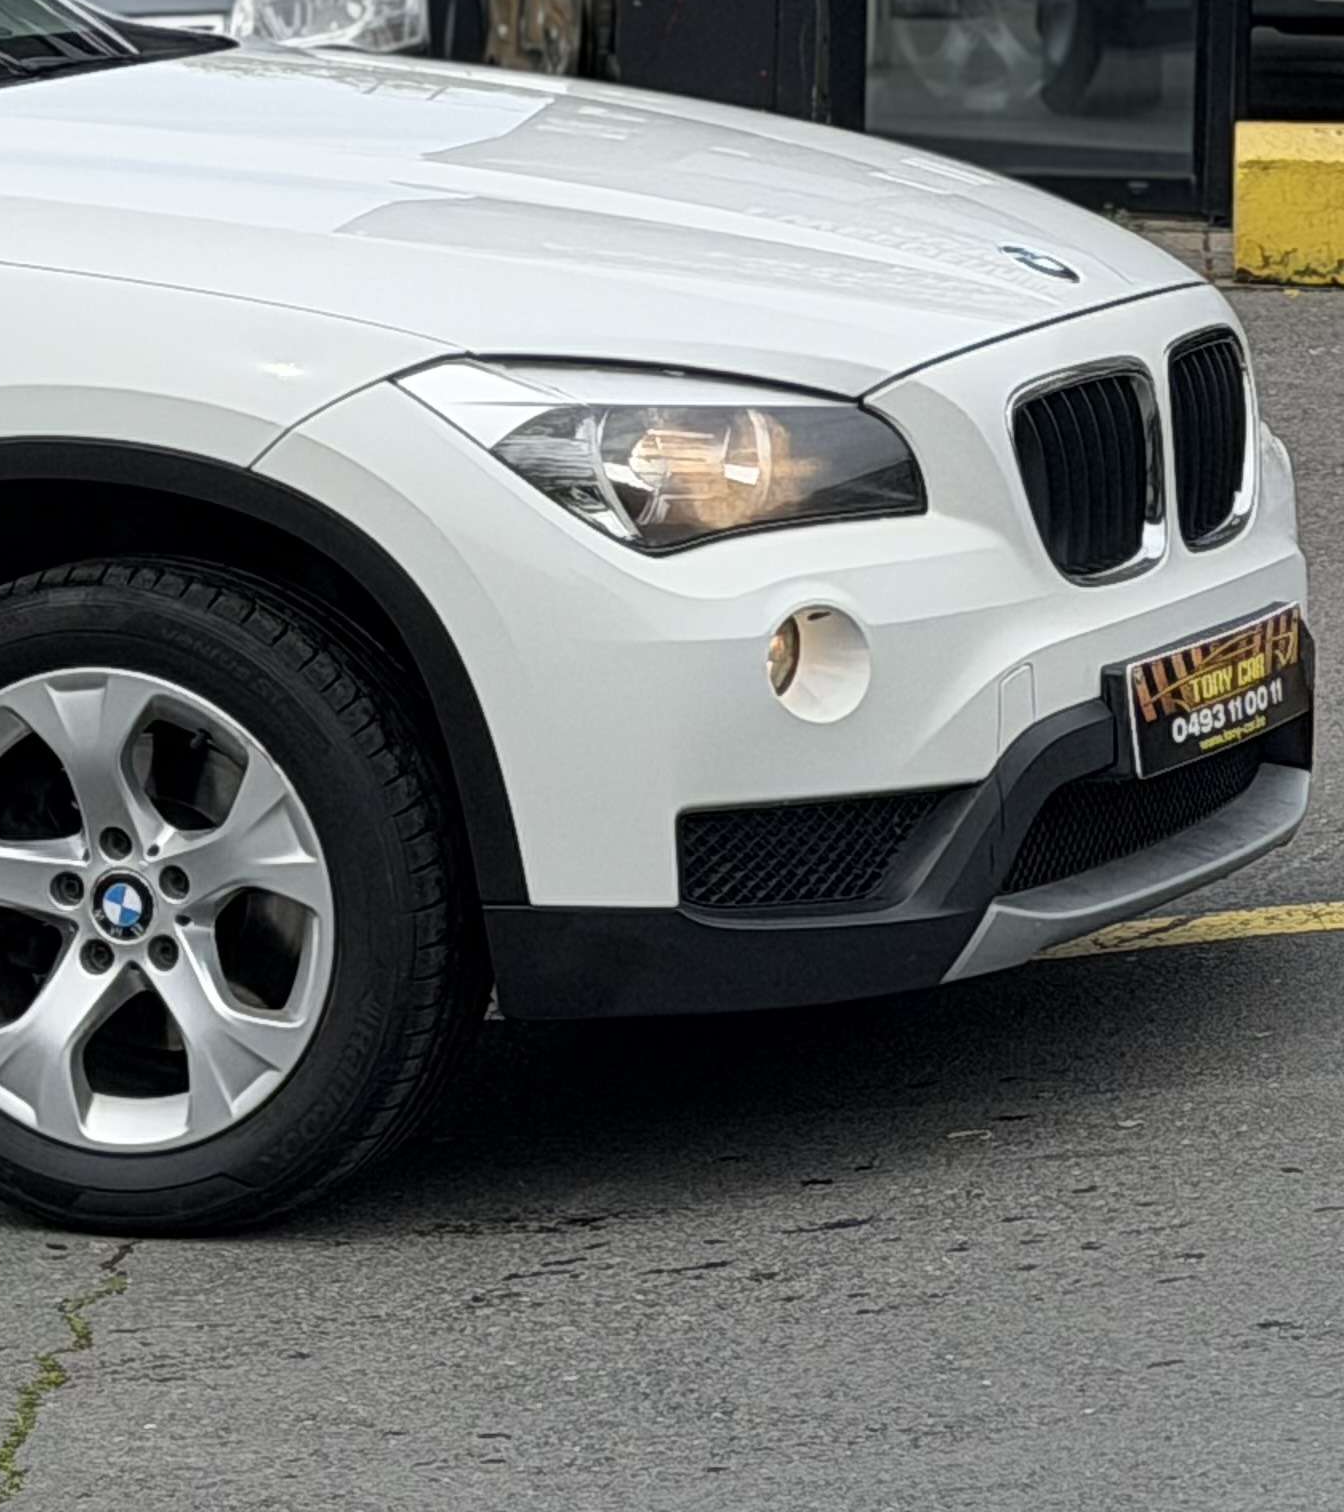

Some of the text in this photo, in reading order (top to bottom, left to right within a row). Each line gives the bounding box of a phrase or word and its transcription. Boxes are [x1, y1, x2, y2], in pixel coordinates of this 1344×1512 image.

[1188, 653, 1265, 703] TONY CAR
[1172, 678, 1283, 744] 0493 11 00 11
